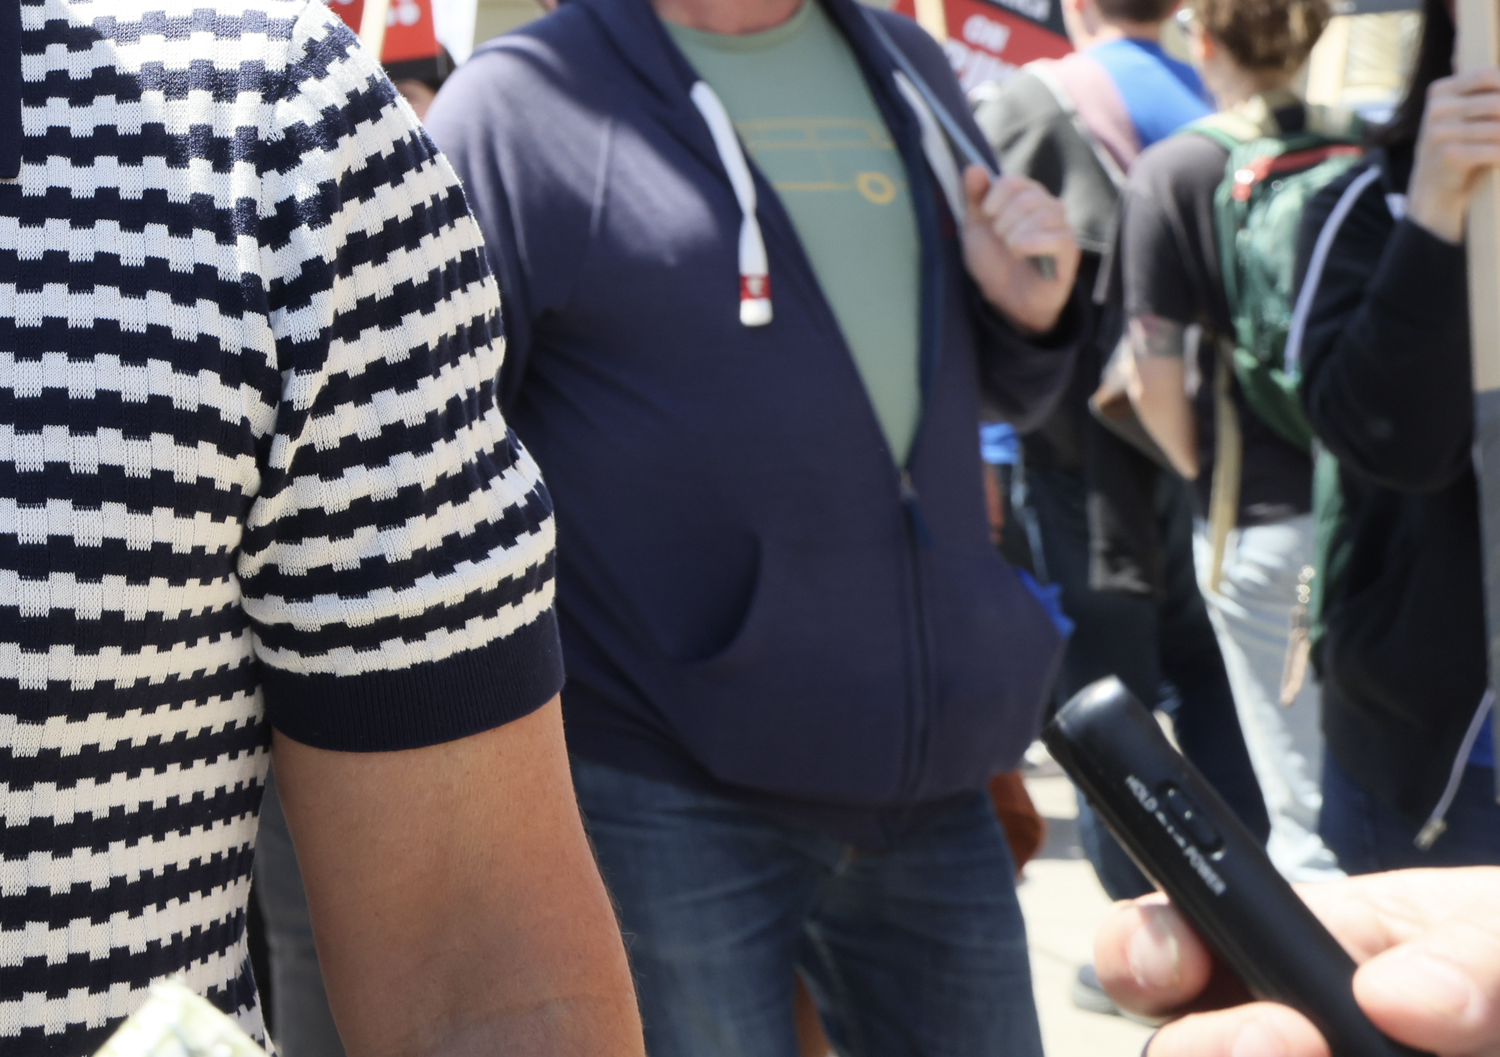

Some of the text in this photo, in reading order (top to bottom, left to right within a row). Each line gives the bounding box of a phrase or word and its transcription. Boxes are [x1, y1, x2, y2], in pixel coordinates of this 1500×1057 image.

[962, 13, 1011, 54] ON
[1125, 774, 1159, 813] HOLD
[1183, 844, 1227, 897] POWER
